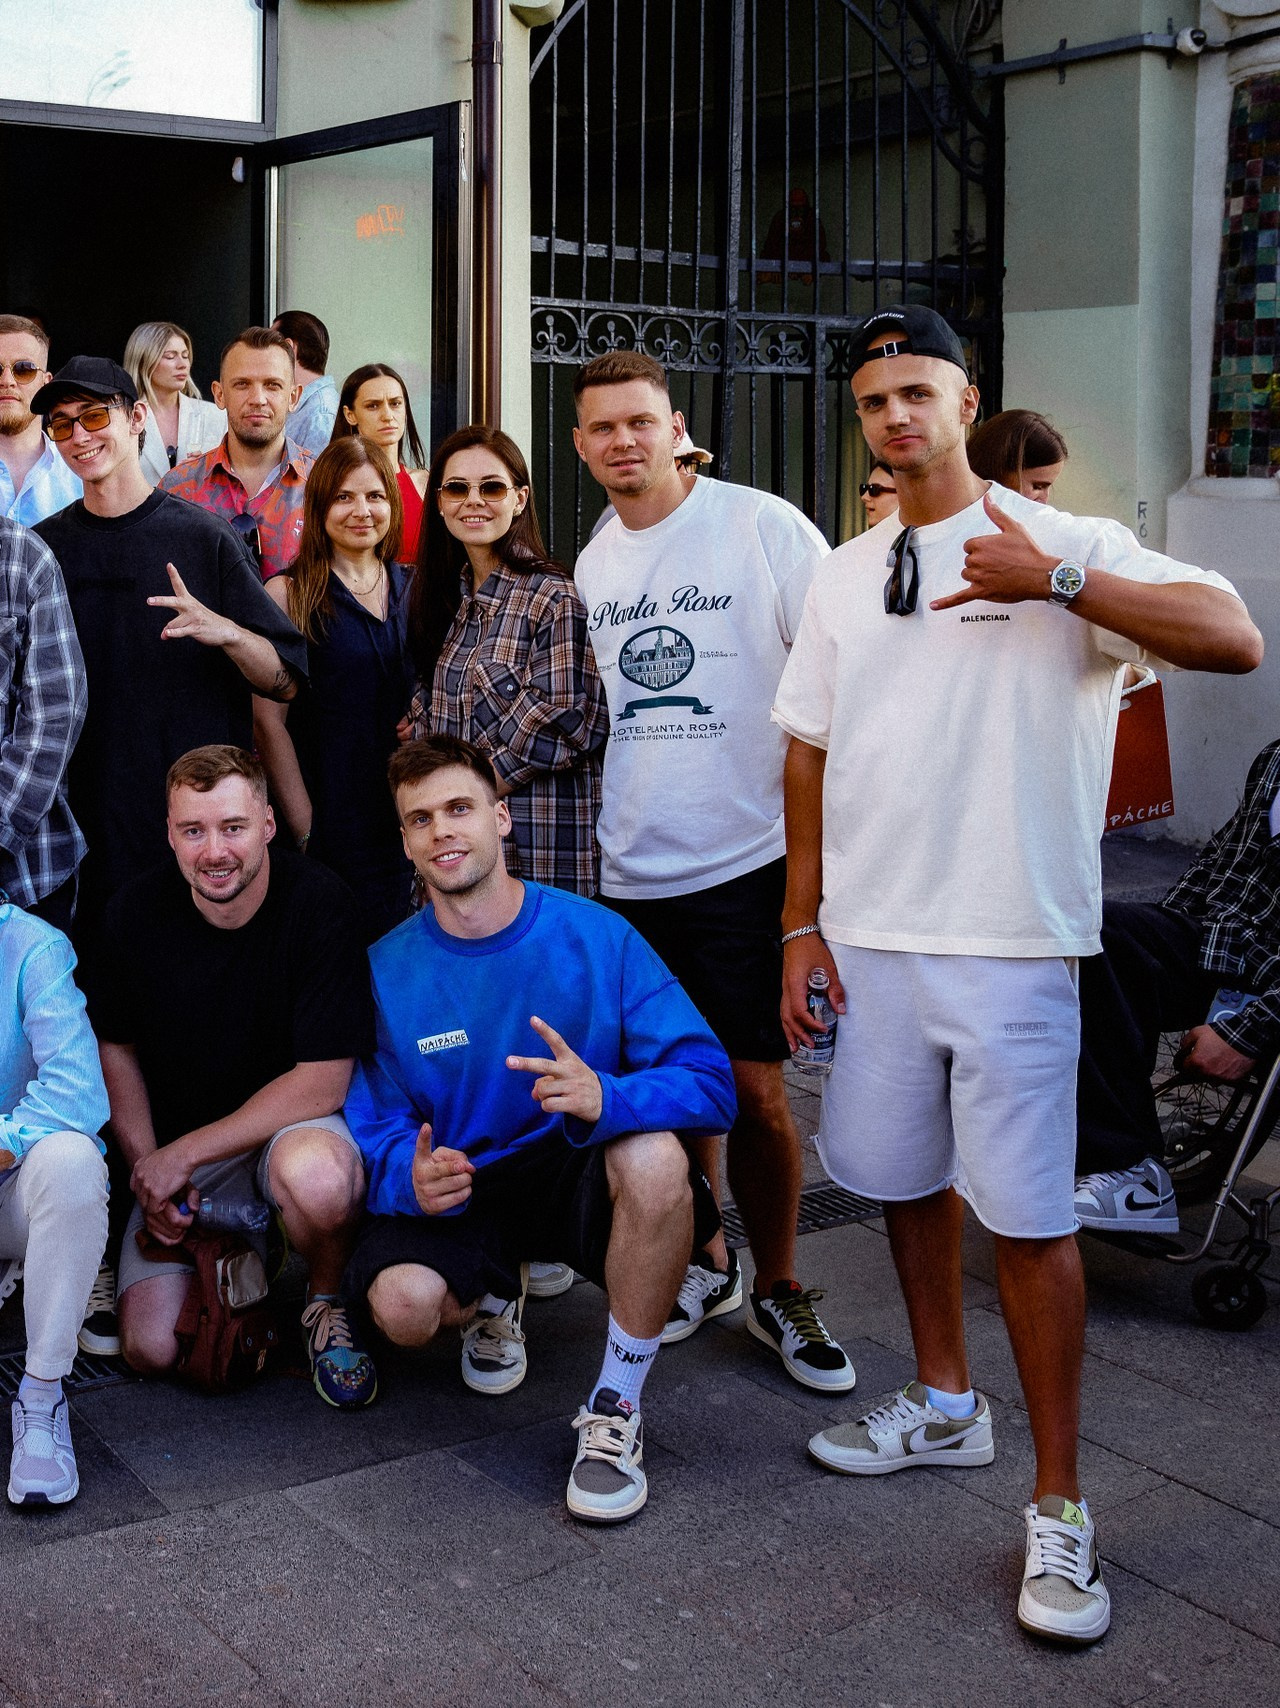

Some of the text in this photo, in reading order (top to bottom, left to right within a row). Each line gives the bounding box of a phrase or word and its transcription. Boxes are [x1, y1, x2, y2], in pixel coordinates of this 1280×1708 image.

[589, 584, 733, 631] Planta Rosa
[960, 614, 1010, 623] BALENCIAGA
[610, 722, 727, 738] HOTEL PLANTA ROSA
[686, 732, 723, 740] QUALITY
